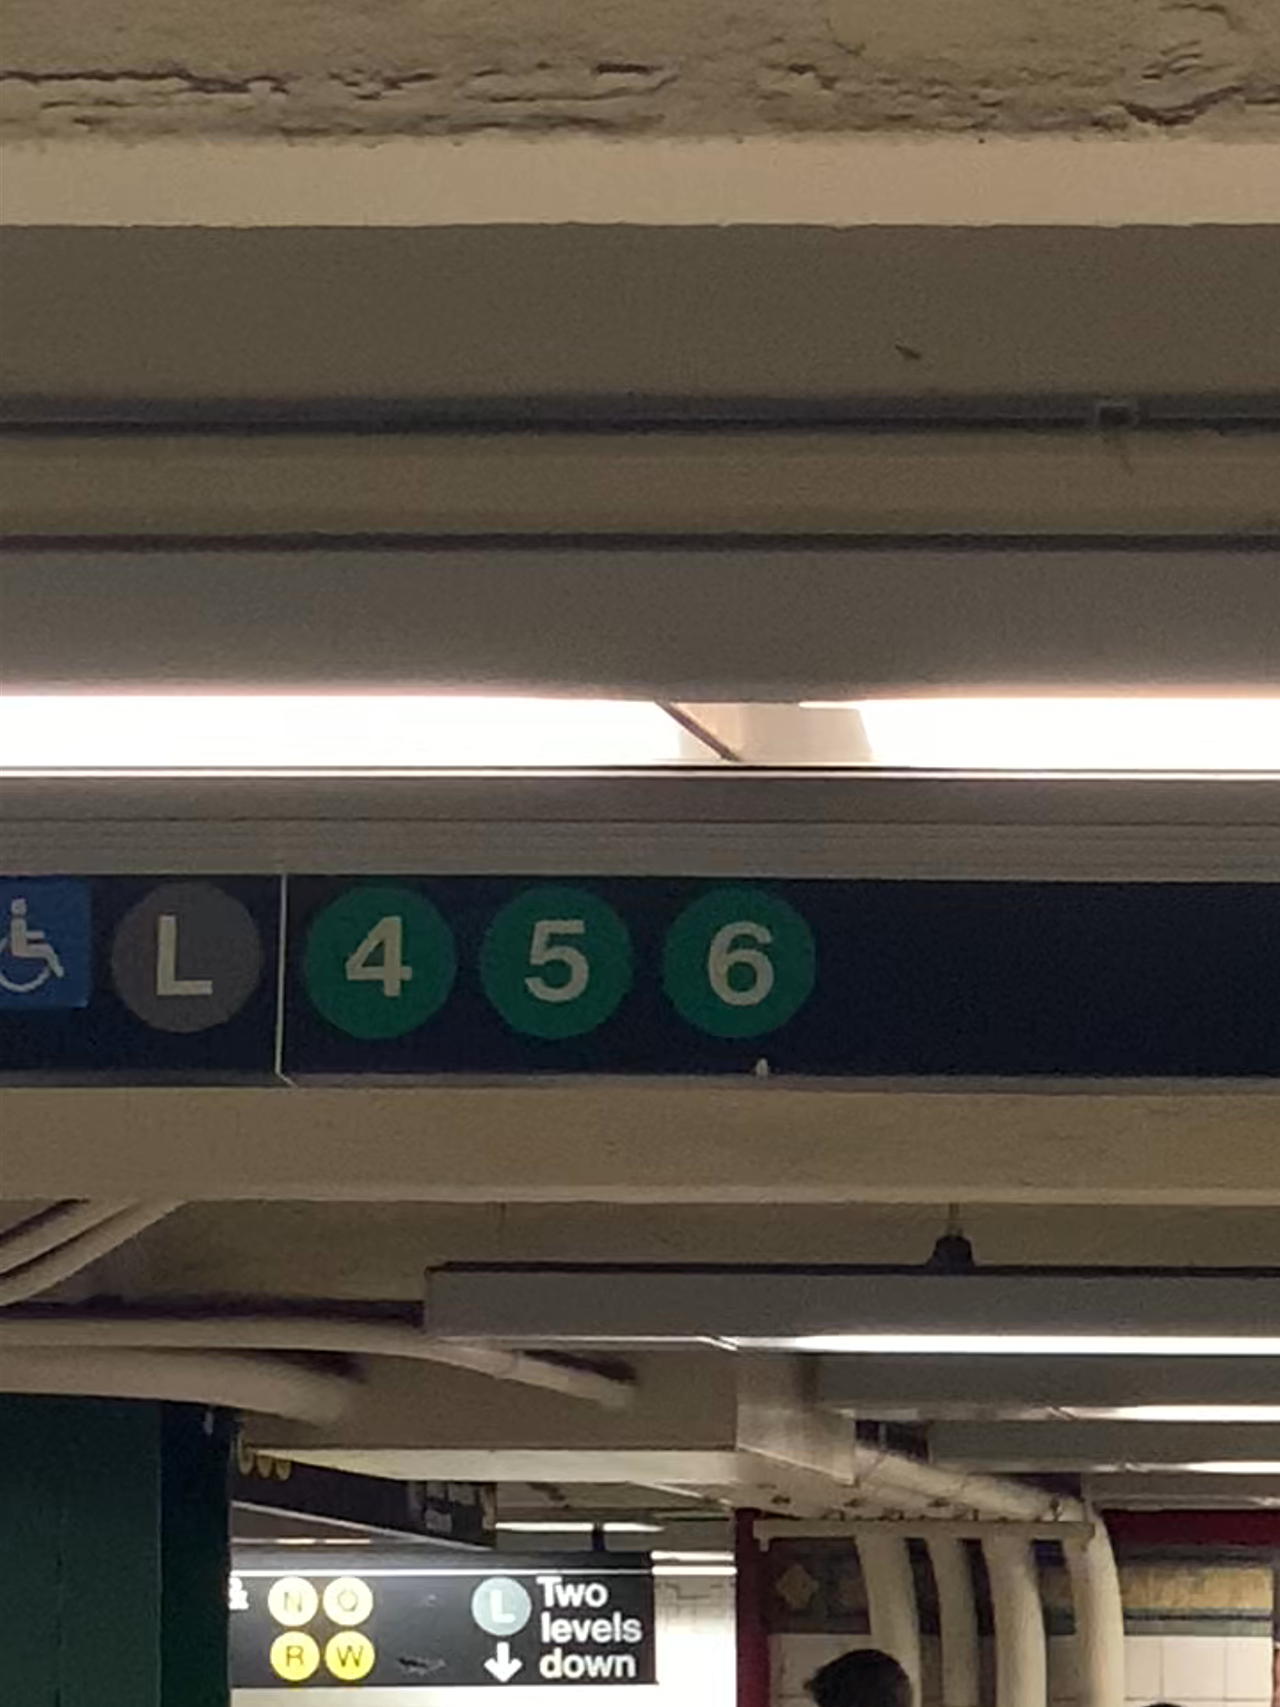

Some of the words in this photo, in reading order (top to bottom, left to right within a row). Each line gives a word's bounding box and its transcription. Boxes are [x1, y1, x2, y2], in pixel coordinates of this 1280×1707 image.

[156, 916, 213, 996] L
[345, 917, 412, 997] 4
[524, 920, 590, 1003] 5
[707, 923, 775, 1005] 6
[491, 1590, 516, 1623] L
[536, 1576, 608, 1608] Two
[541, 1611, 643, 1643] levels
[286, 1645, 304, 1667] R
[337, 1645, 364, 1668] W
[540, 1647, 637, 1679] down
